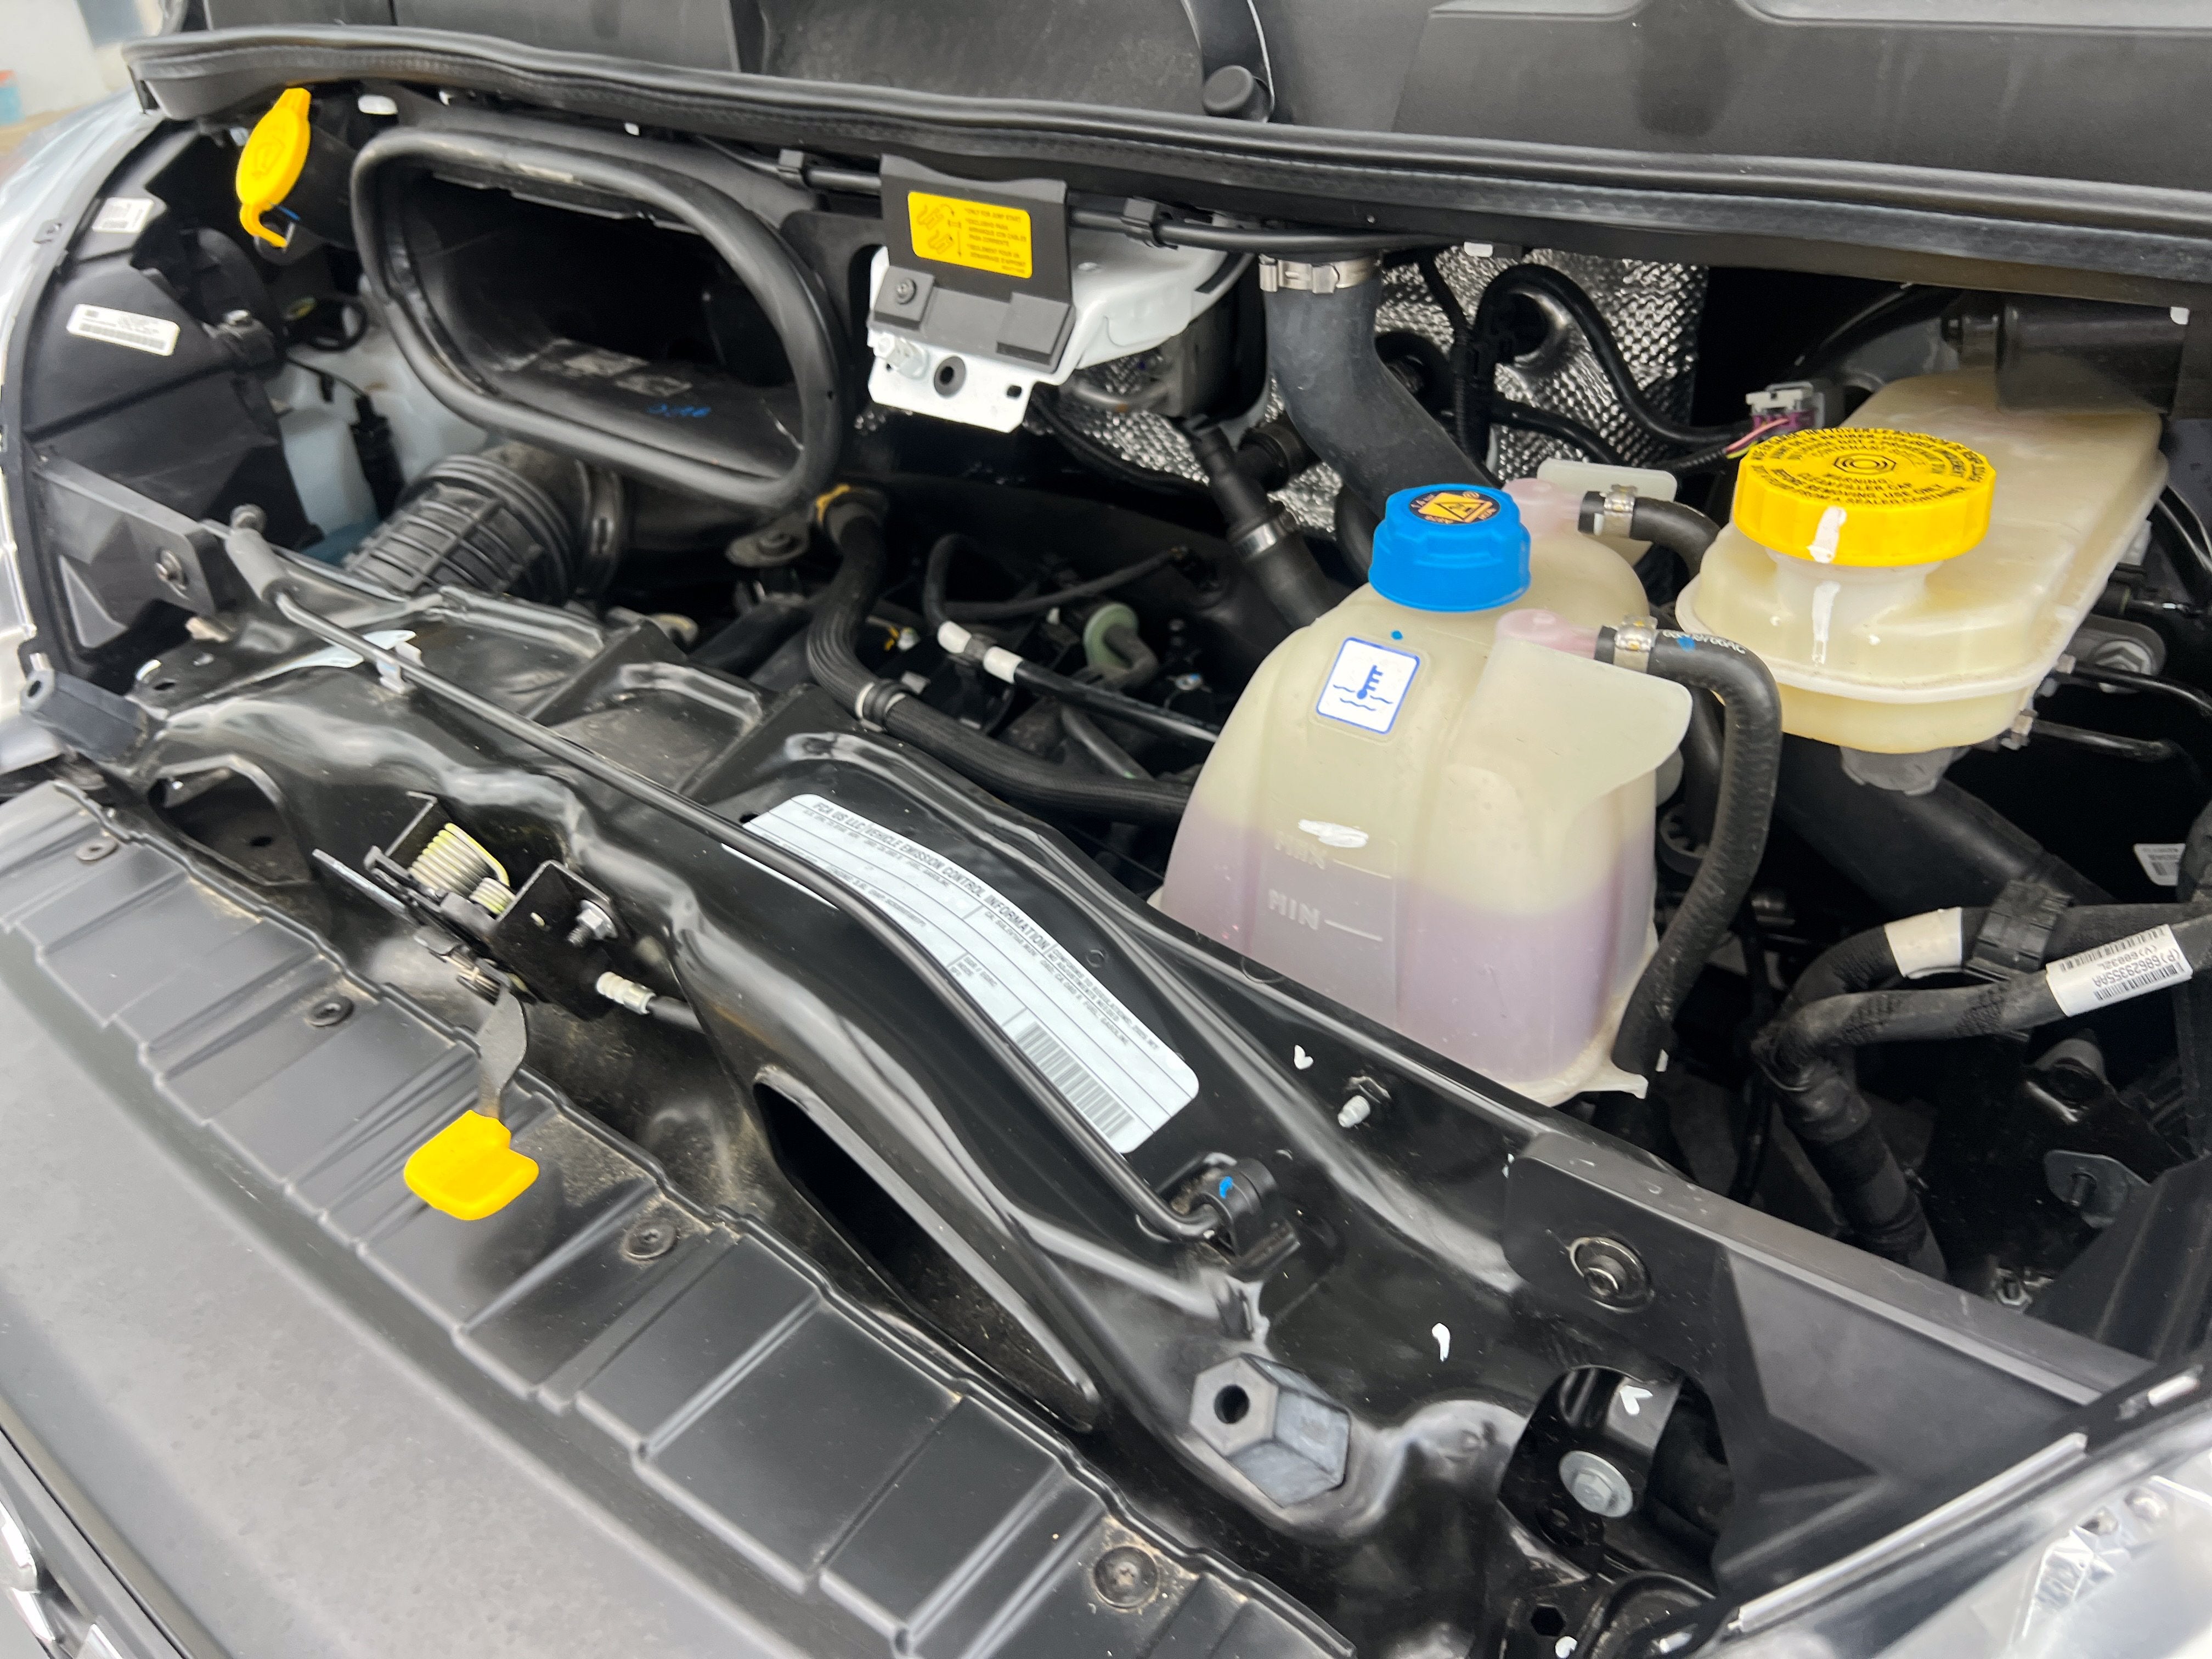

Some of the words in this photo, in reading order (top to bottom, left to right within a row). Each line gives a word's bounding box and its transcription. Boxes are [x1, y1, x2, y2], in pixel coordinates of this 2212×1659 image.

[813, 803, 834, 814] FCA
[832, 811, 848, 822] US
[845, 817, 865, 830] LLC
[866, 827, 904, 847] VEHICLE
[900, 843, 945, 870] EMISSION
[942, 867, 986, 898] CONTROL
[983, 894, 1051, 951] INFORMATION
[1267, 888, 1321, 931] MIN
